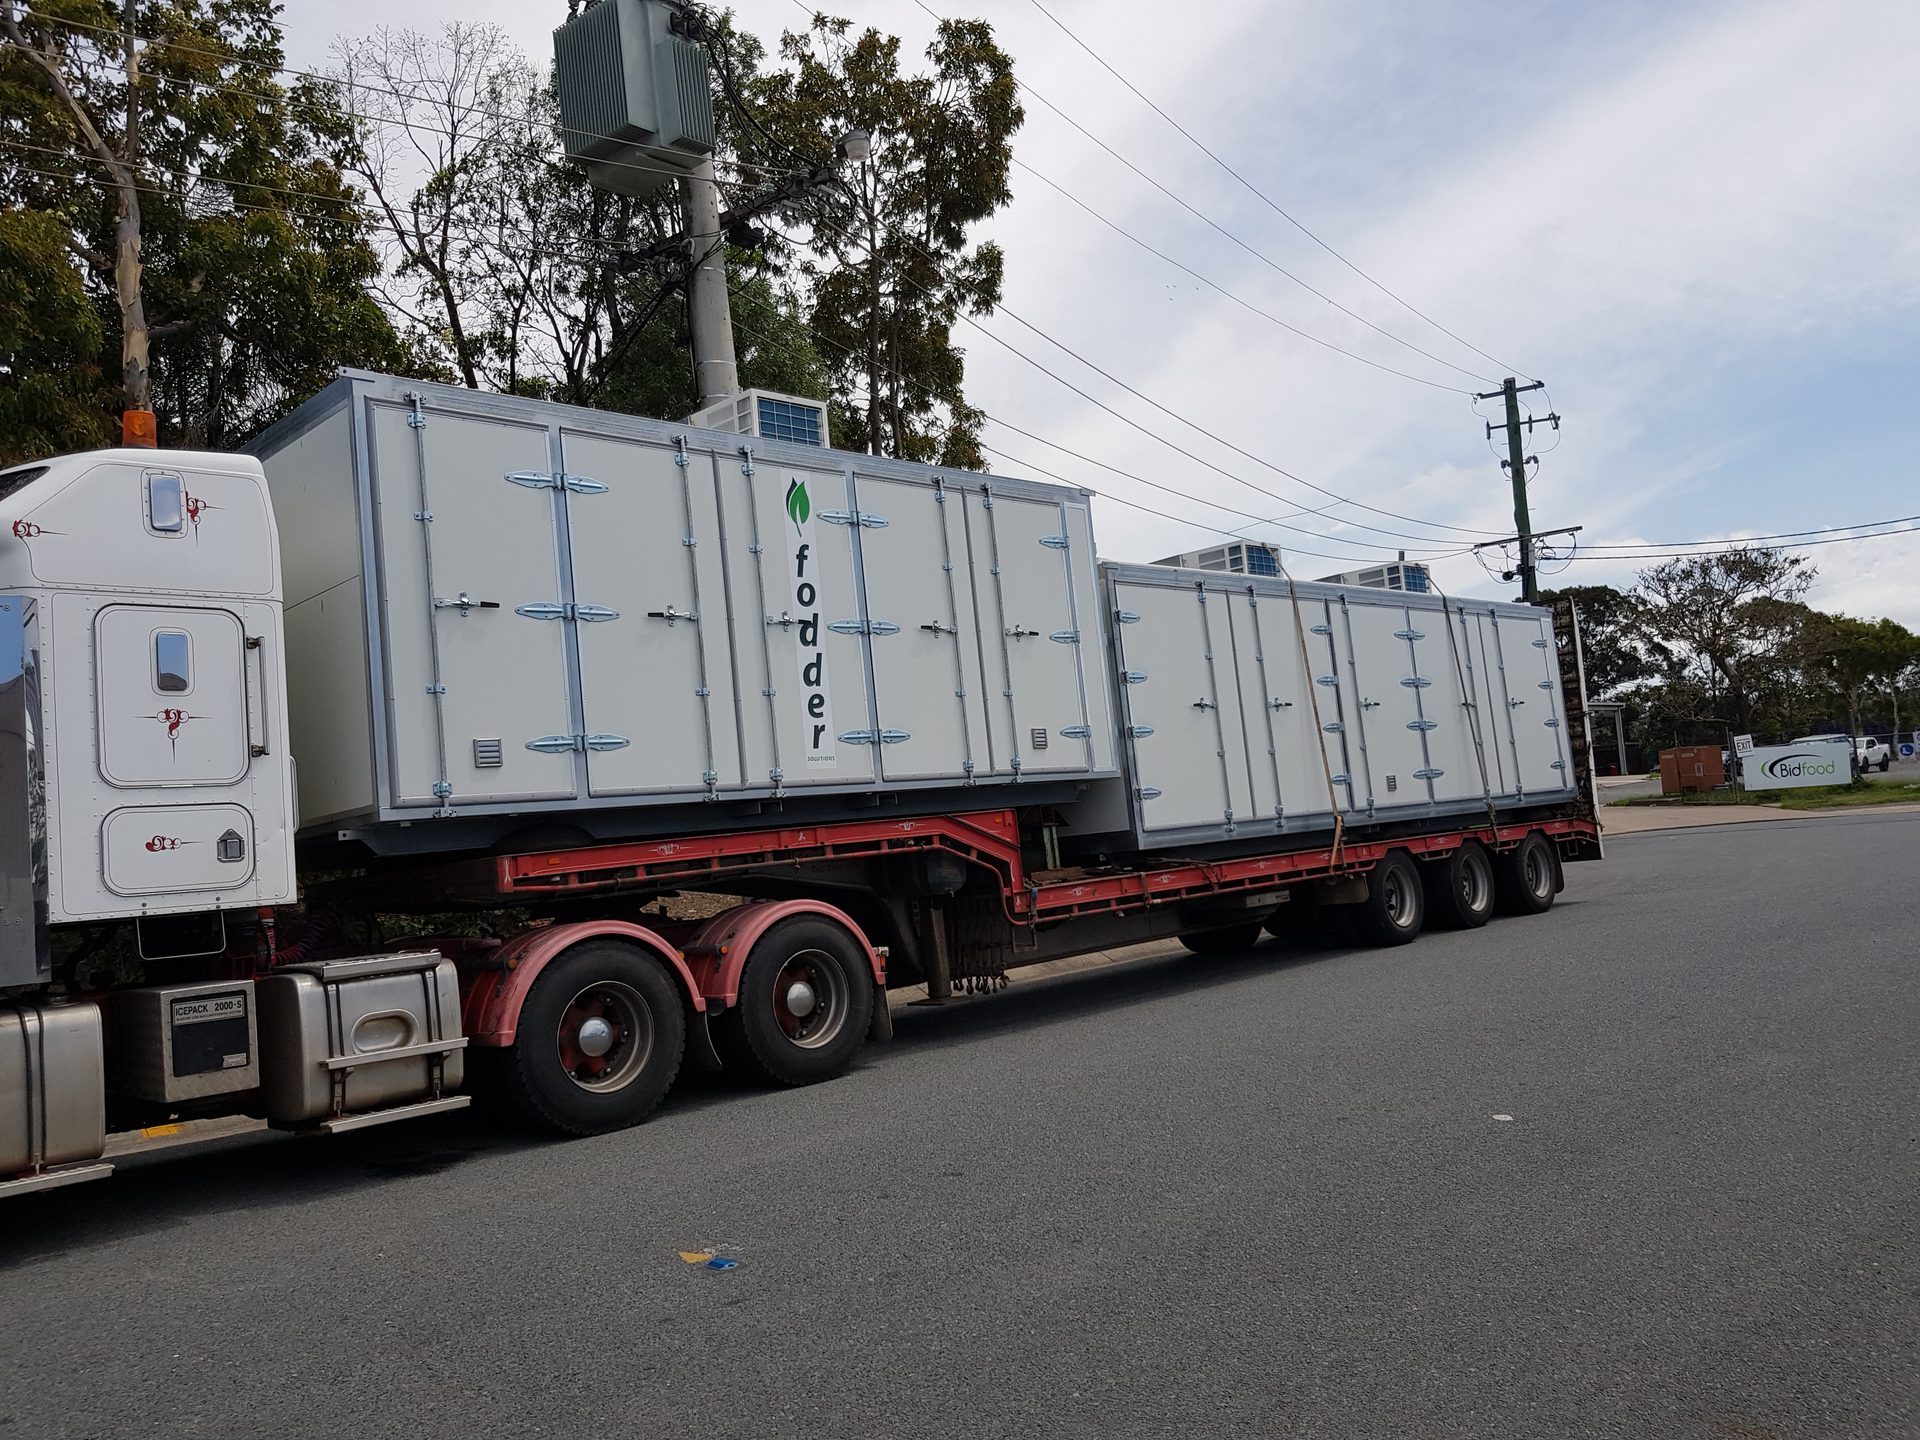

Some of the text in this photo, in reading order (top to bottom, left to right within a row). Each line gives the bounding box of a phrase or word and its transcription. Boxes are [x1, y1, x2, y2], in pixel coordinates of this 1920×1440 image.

[796, 544, 826, 749] fodder
[1736, 741, 1752, 751] EXIT
[1780, 761, 1835, 778] Bidfood
[175, 1004, 209, 1017] ICEPACK
